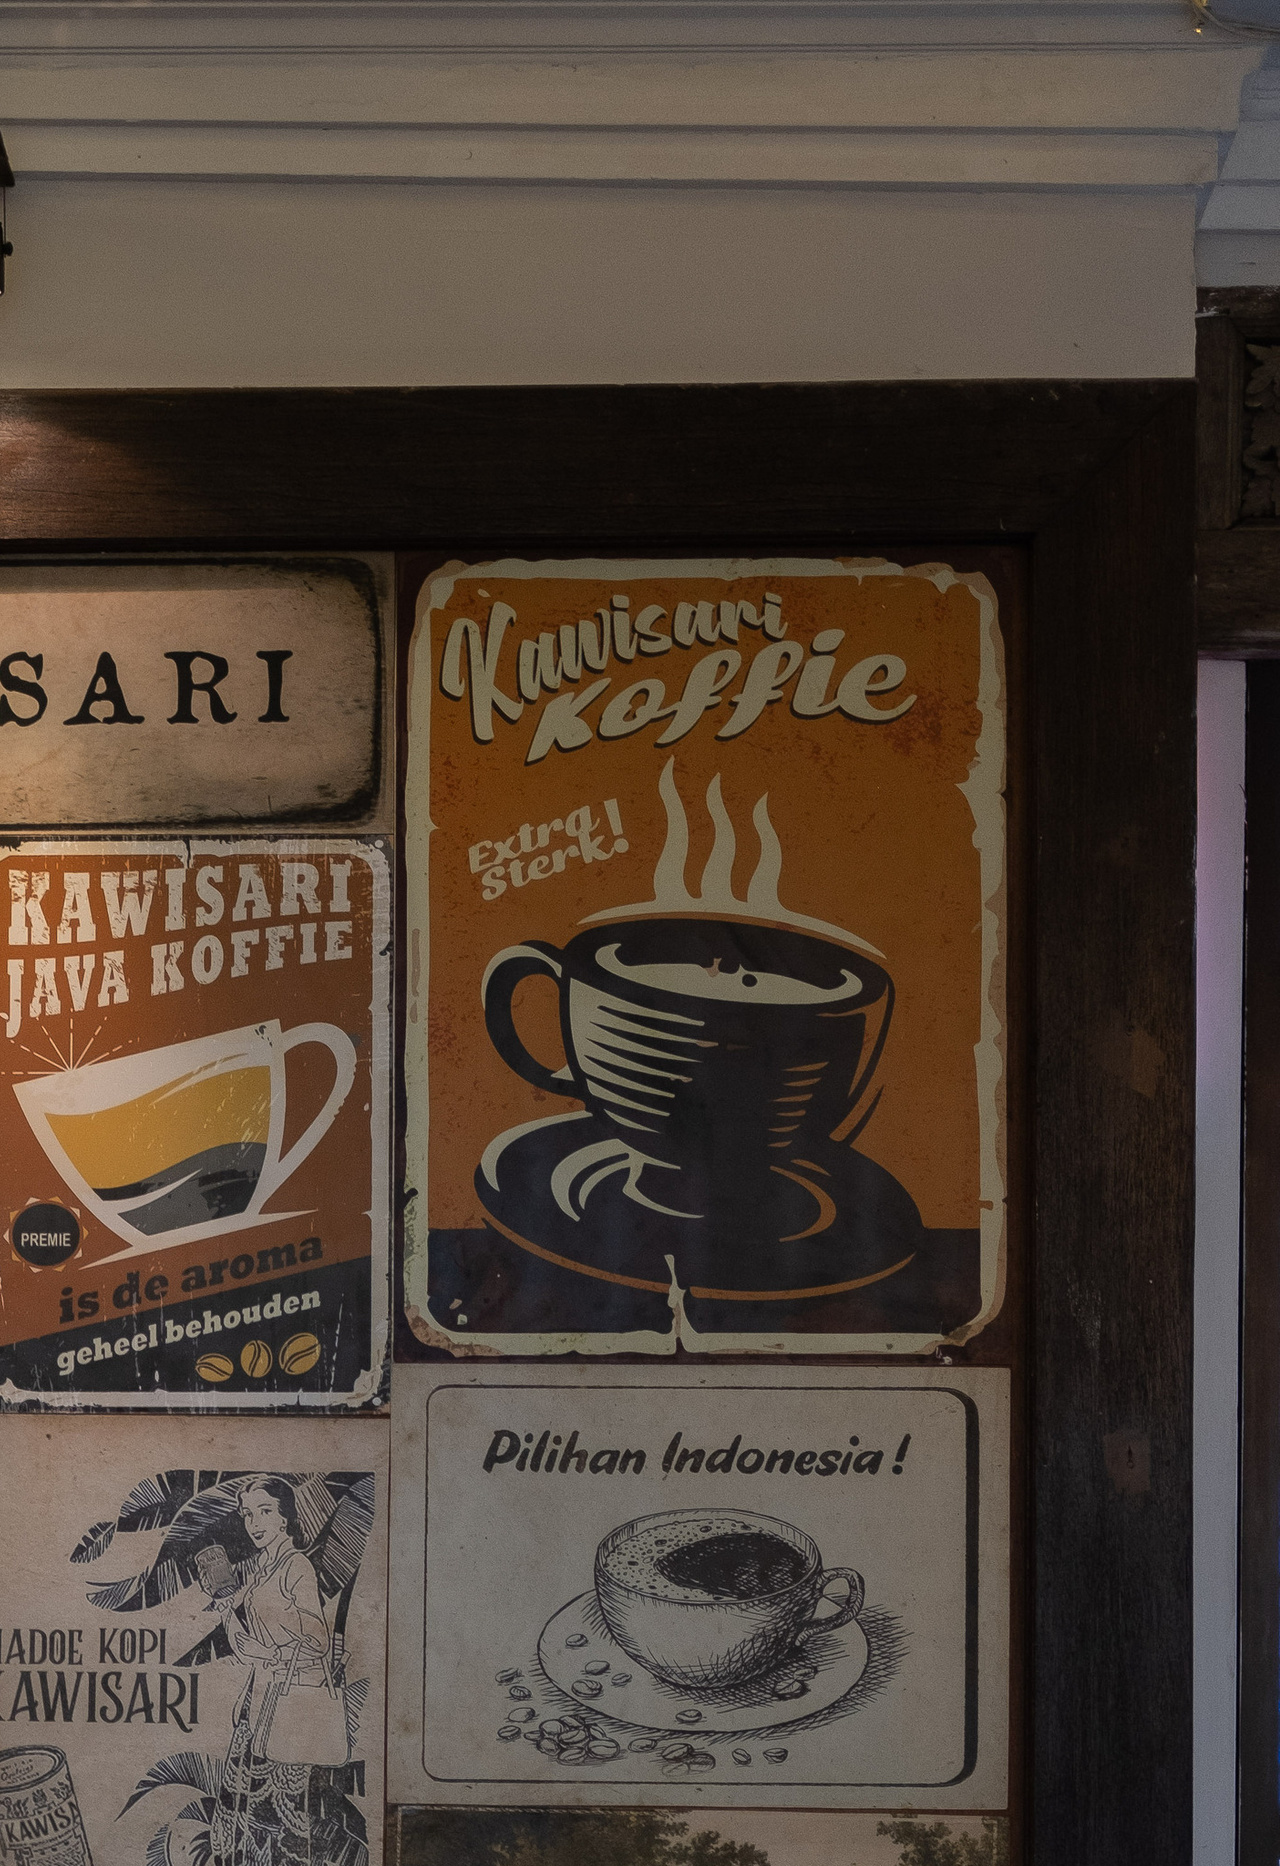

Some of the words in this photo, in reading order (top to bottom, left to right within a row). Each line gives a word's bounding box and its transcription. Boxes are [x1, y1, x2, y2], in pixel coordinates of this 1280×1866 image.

[440, 592, 788, 745] Kawisari
[524, 629, 918, 765] Koffie
[468, 803, 602, 874] Extra
[481, 798, 630, 901] Sterk!
[8, 858, 354, 947] KAWISARI
[5, 948, 131, 1039] JAVA
[150, 920, 354, 997] KOFFIE
[20, 1232, 71, 1247] PREMIE
[58, 1287, 100, 1325] is
[111, 1271, 170, 1308] de
[181, 1235, 324, 1294] aroma
[56, 1328, 160, 1378] geheel
[165, 1290, 322, 1344] behouden
[481, 1428, 647, 1476] Pilihan
[99, 1627, 168, 1666] KOPI
